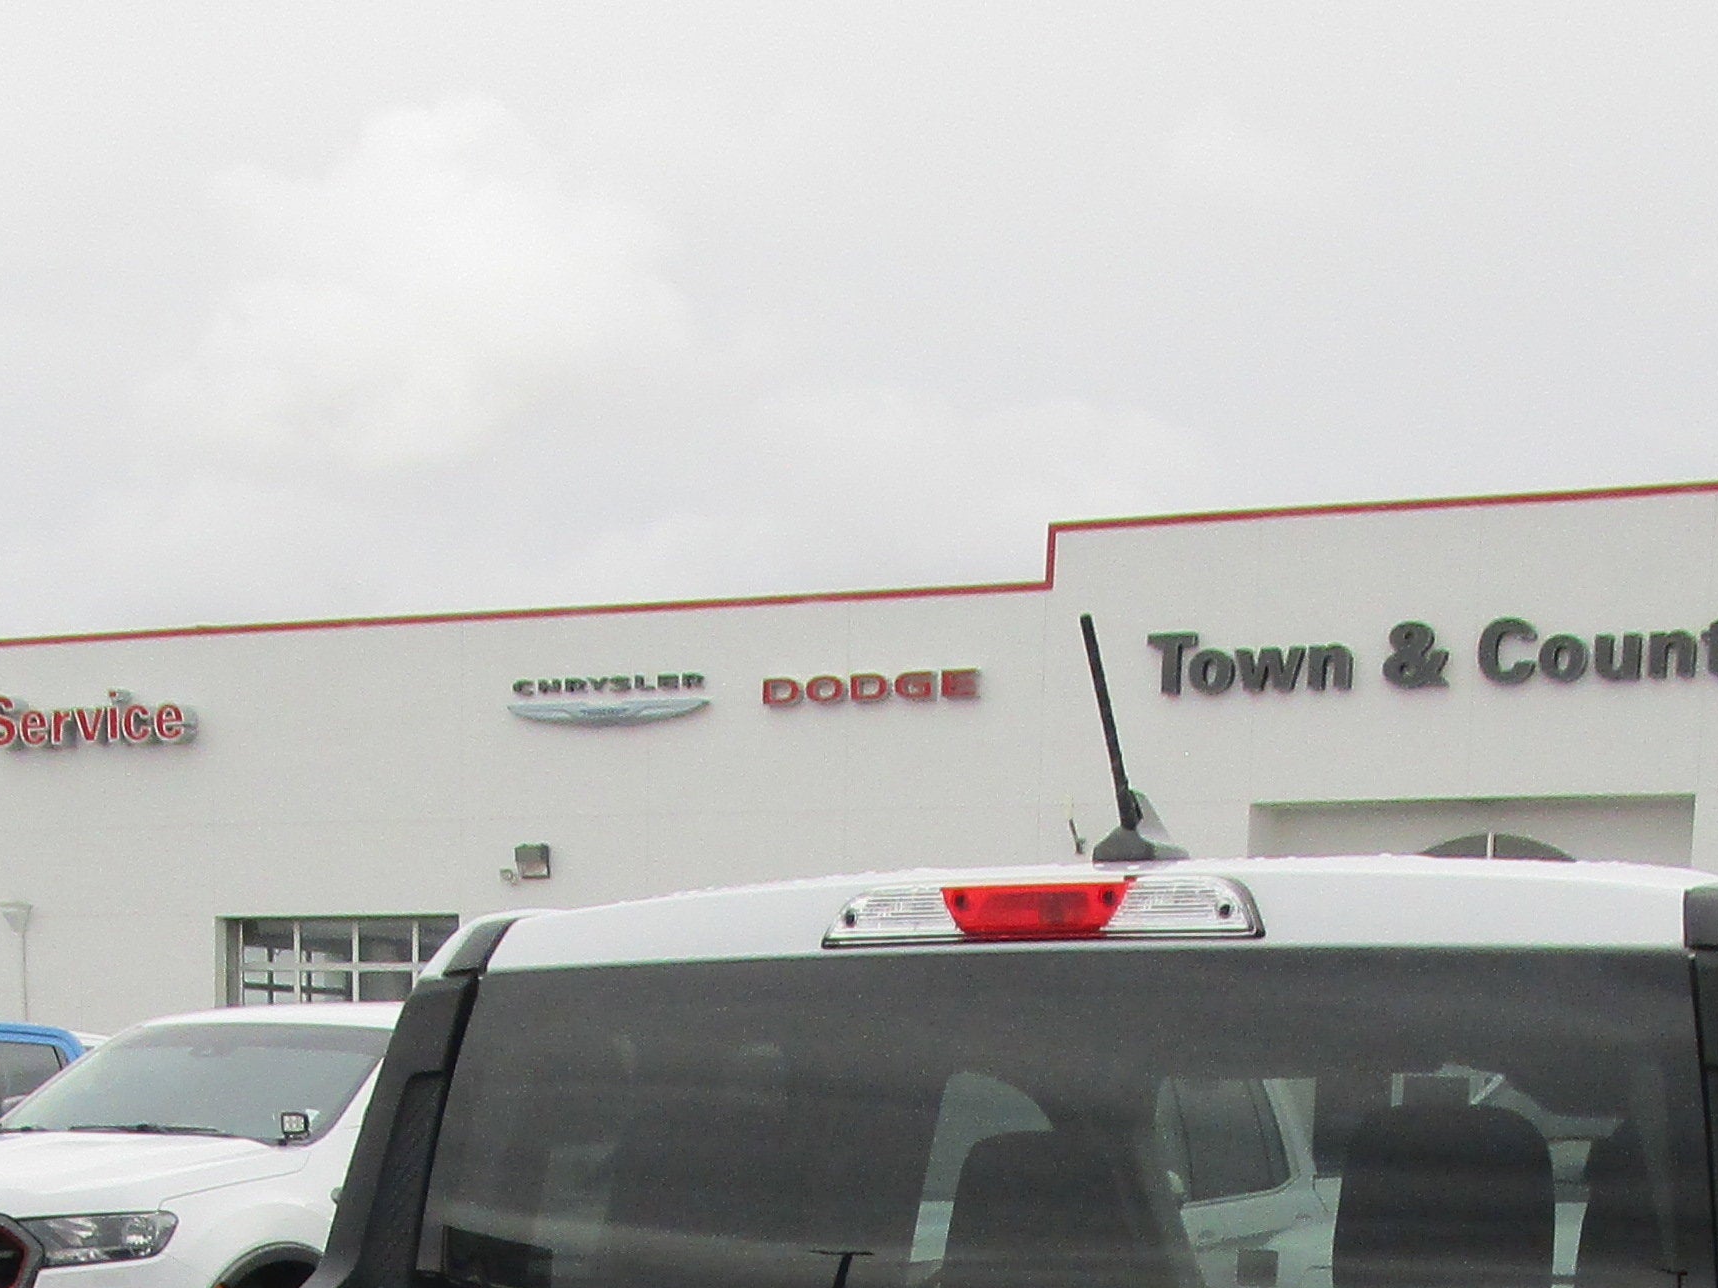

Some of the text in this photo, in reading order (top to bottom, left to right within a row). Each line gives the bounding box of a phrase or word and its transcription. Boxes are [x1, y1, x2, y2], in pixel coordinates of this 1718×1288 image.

[1148, 630, 1354, 698] Town
[1382, 619, 1451, 690] &
[511, 671, 706, 697] CHRYSLER
[762, 668, 981, 706] DODGE
